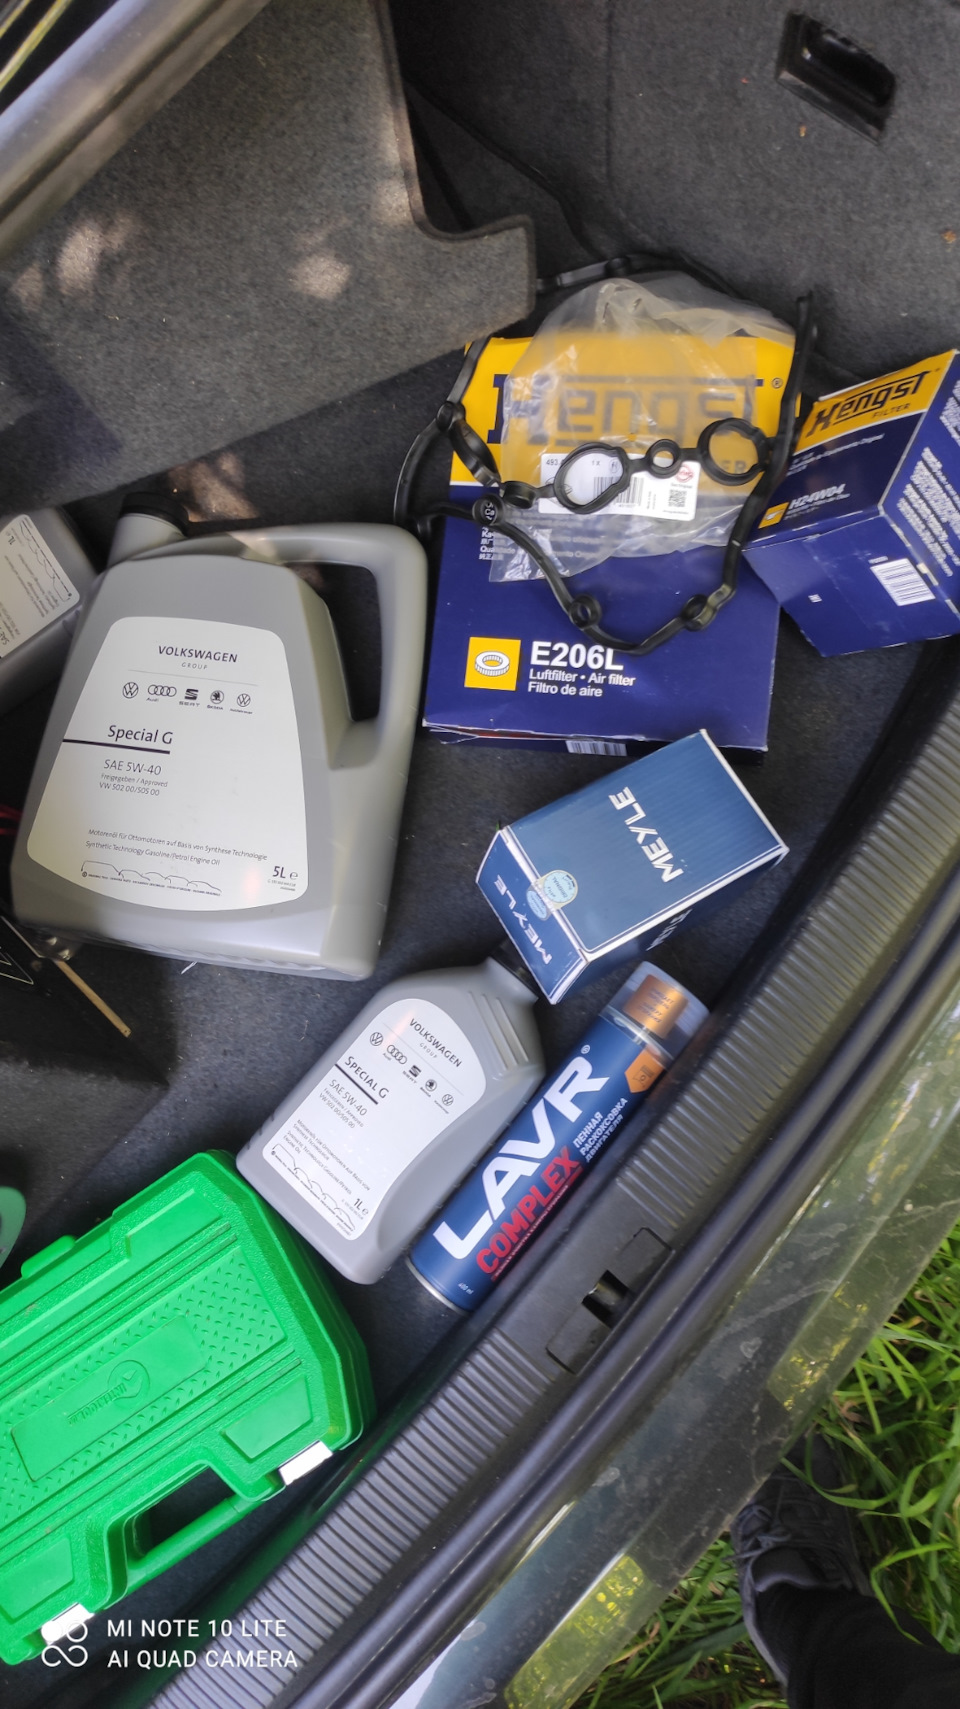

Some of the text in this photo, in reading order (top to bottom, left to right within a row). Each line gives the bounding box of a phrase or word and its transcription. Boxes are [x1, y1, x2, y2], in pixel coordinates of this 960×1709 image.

[487, 374, 763, 446] Hengst
[806, 371, 930, 437] Hengst
[873, 403, 910, 418] FILTER
[789, 484, 846, 510] H24W04
[158, 645, 238, 663] VOLKSWAGEN
[181, 662, 208, 670] GROUP
[531, 641, 624, 670] E206L
[528, 681, 603, 697] Filtro de aire
[529, 668, 636, 687] Luftfilter Air filter
[108, 724, 173, 744] Special G
[104, 759, 161, 776] SAE 5W-40
[100, 781, 160, 796] VW 502 00/505 00
[140, 778, 168, 788] Approved
[88, 829, 117, 838] Motorenöl
[127, 834, 165, 846] Ottomotoren
[205, 845, 232, 856] Synthese
[232, 848, 267, 861] Technologie
[609, 786, 684, 882] MEYLE
[85, 840, 112, 850] Synthetic
[113, 844, 144, 857] Technology
[190, 856, 210, 866] Engine
[273, 865, 286, 878] 5L
[494, 875, 553, 965] MEYLE
[409, 1018, 462, 1067] VOLKSWAGEN
[328, 1078, 368, 1116] SAE 5W-40
[376, 1085, 389, 1099] G
[573, 1111, 603, 1149] ПЕННАЯ
[579, 1097, 628, 1157] РАСКОКСОВКА
[586, 1114, 624, 1163] ДВИГАТЕЛЯ
[433, 1056, 609, 1259] LAVR
[352, 1197, 365, 1210] 1L
[476, 1146, 582, 1275] COMPLEX
